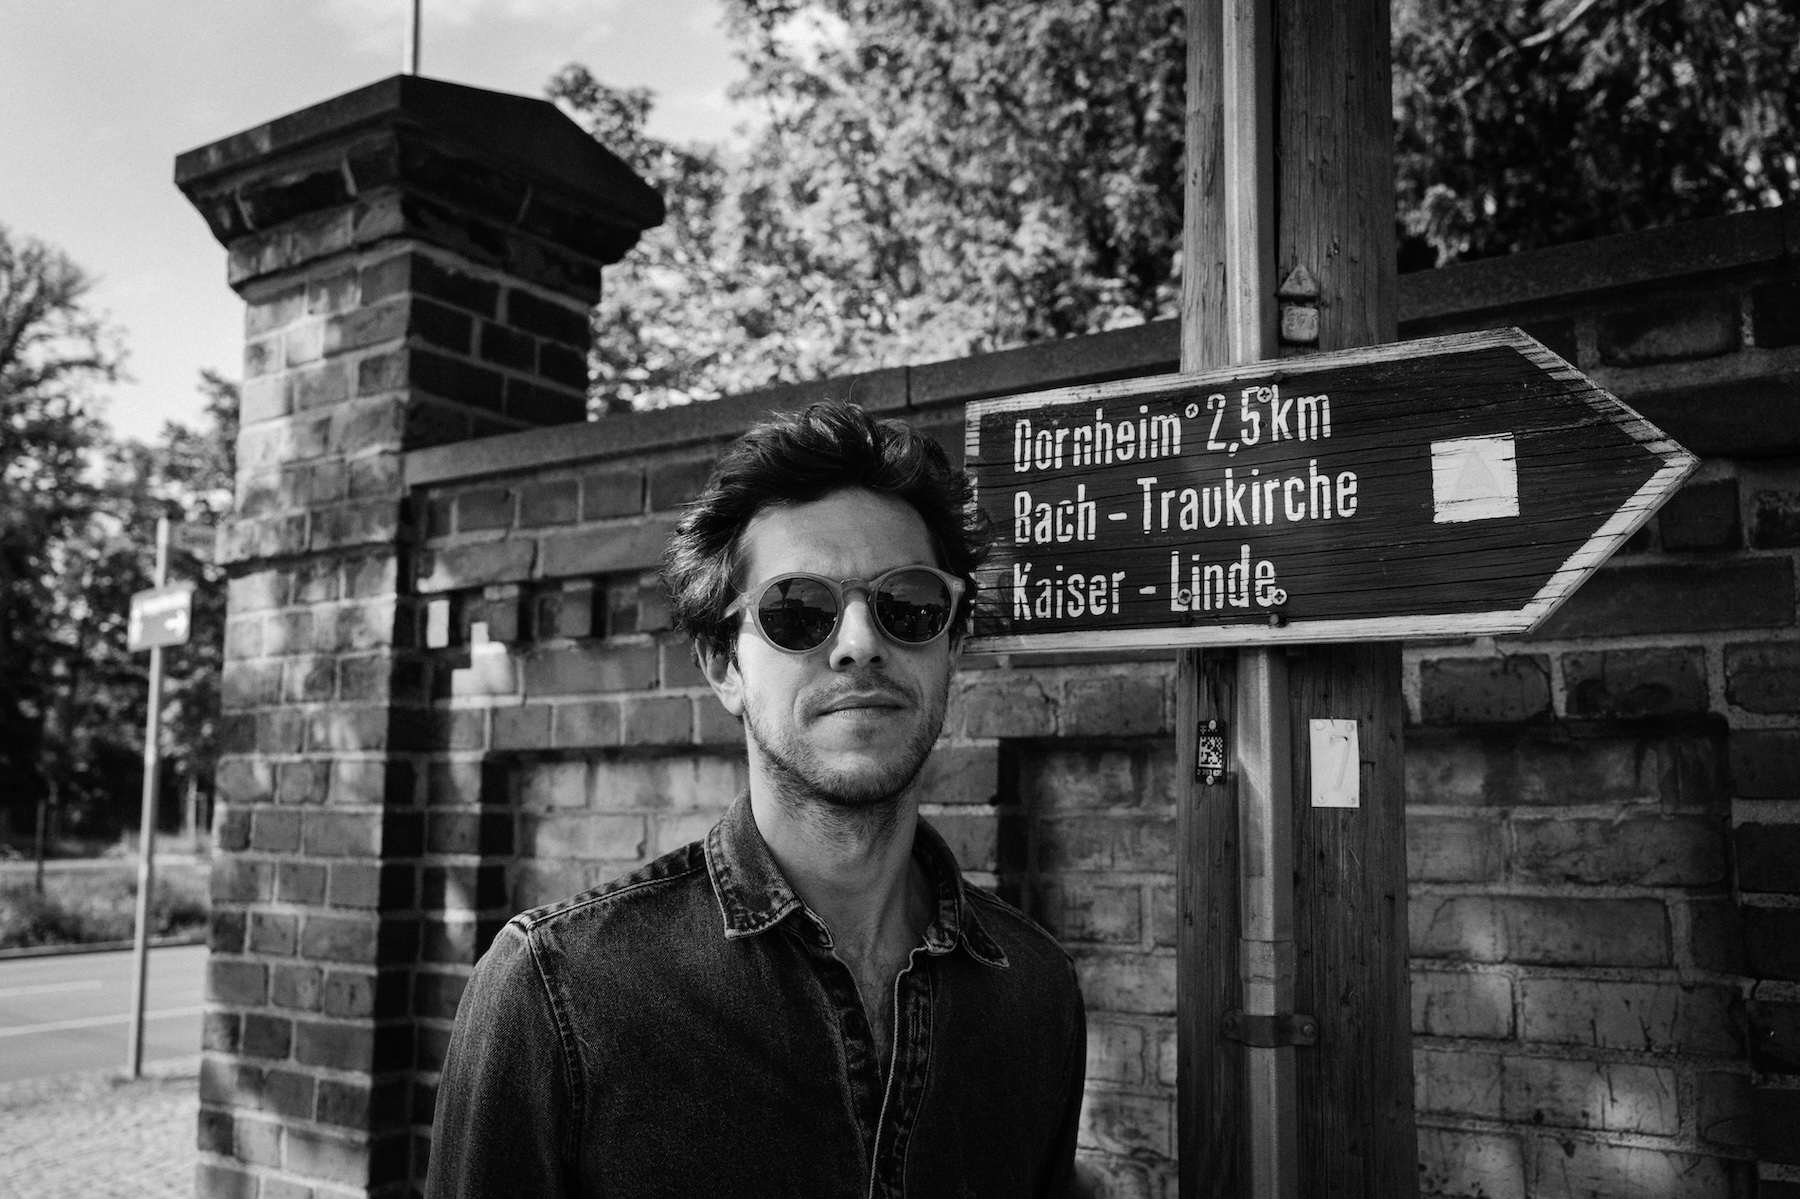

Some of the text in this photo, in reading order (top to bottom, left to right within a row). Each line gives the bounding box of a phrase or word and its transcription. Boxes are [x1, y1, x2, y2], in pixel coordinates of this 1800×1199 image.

[1013, 405, 1183, 472] Dornheim
[1013, 484, 1097, 545] Bach
[1137, 459, 1359, 534] Traukirche
[1012, 562, 1126, 621] Kaiser
[1170, 544, 1277, 613] Linde
